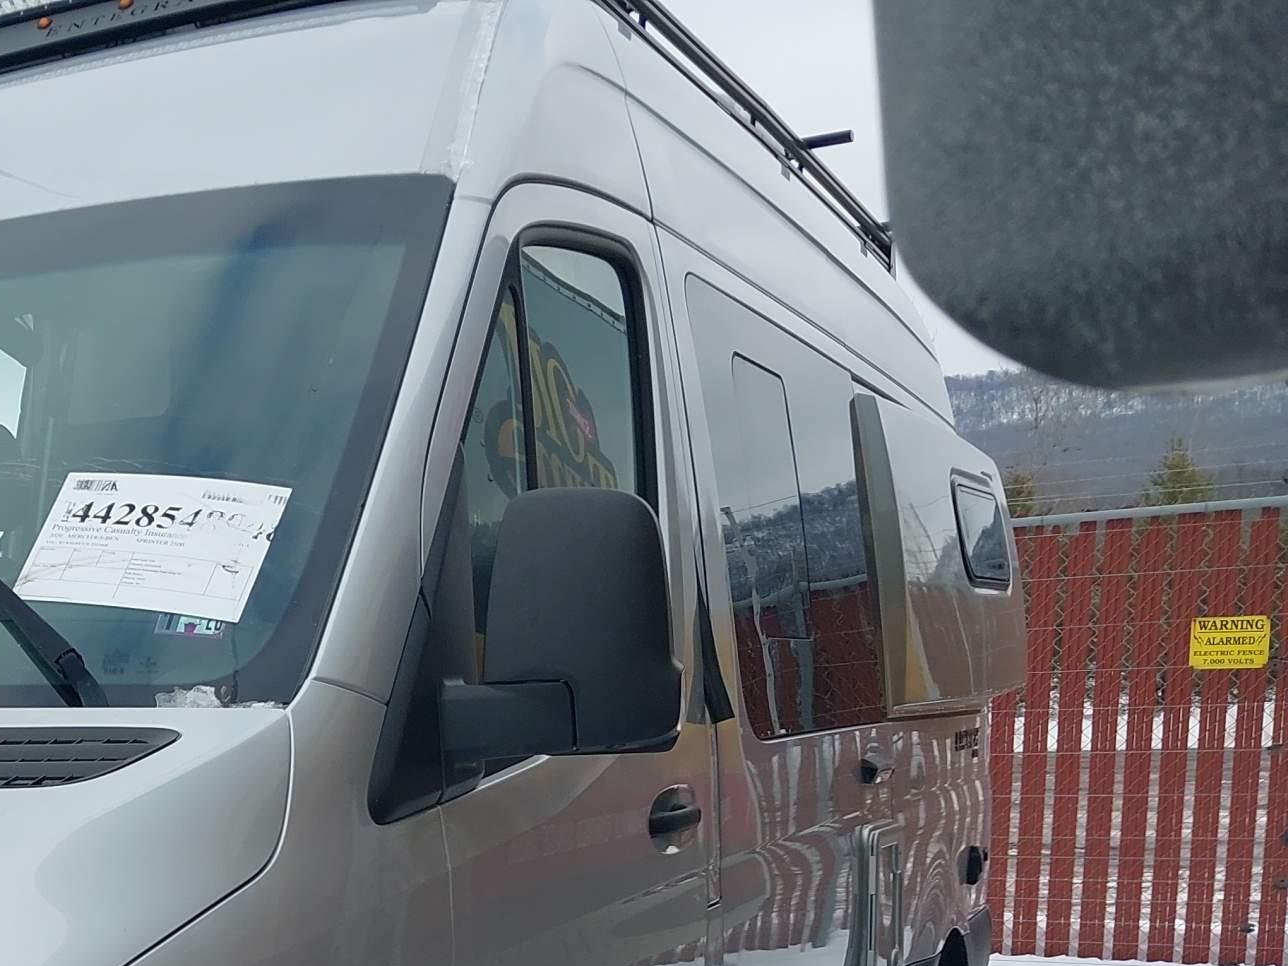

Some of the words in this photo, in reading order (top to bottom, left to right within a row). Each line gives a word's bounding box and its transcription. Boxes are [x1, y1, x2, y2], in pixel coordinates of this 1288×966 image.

[51, 523, 101, 534] Progressive
[103, 525, 142, 537] Casualty
[1198, 619, 1266, 631] WARNING
[1204, 636, 1256, 646] ALARMED
